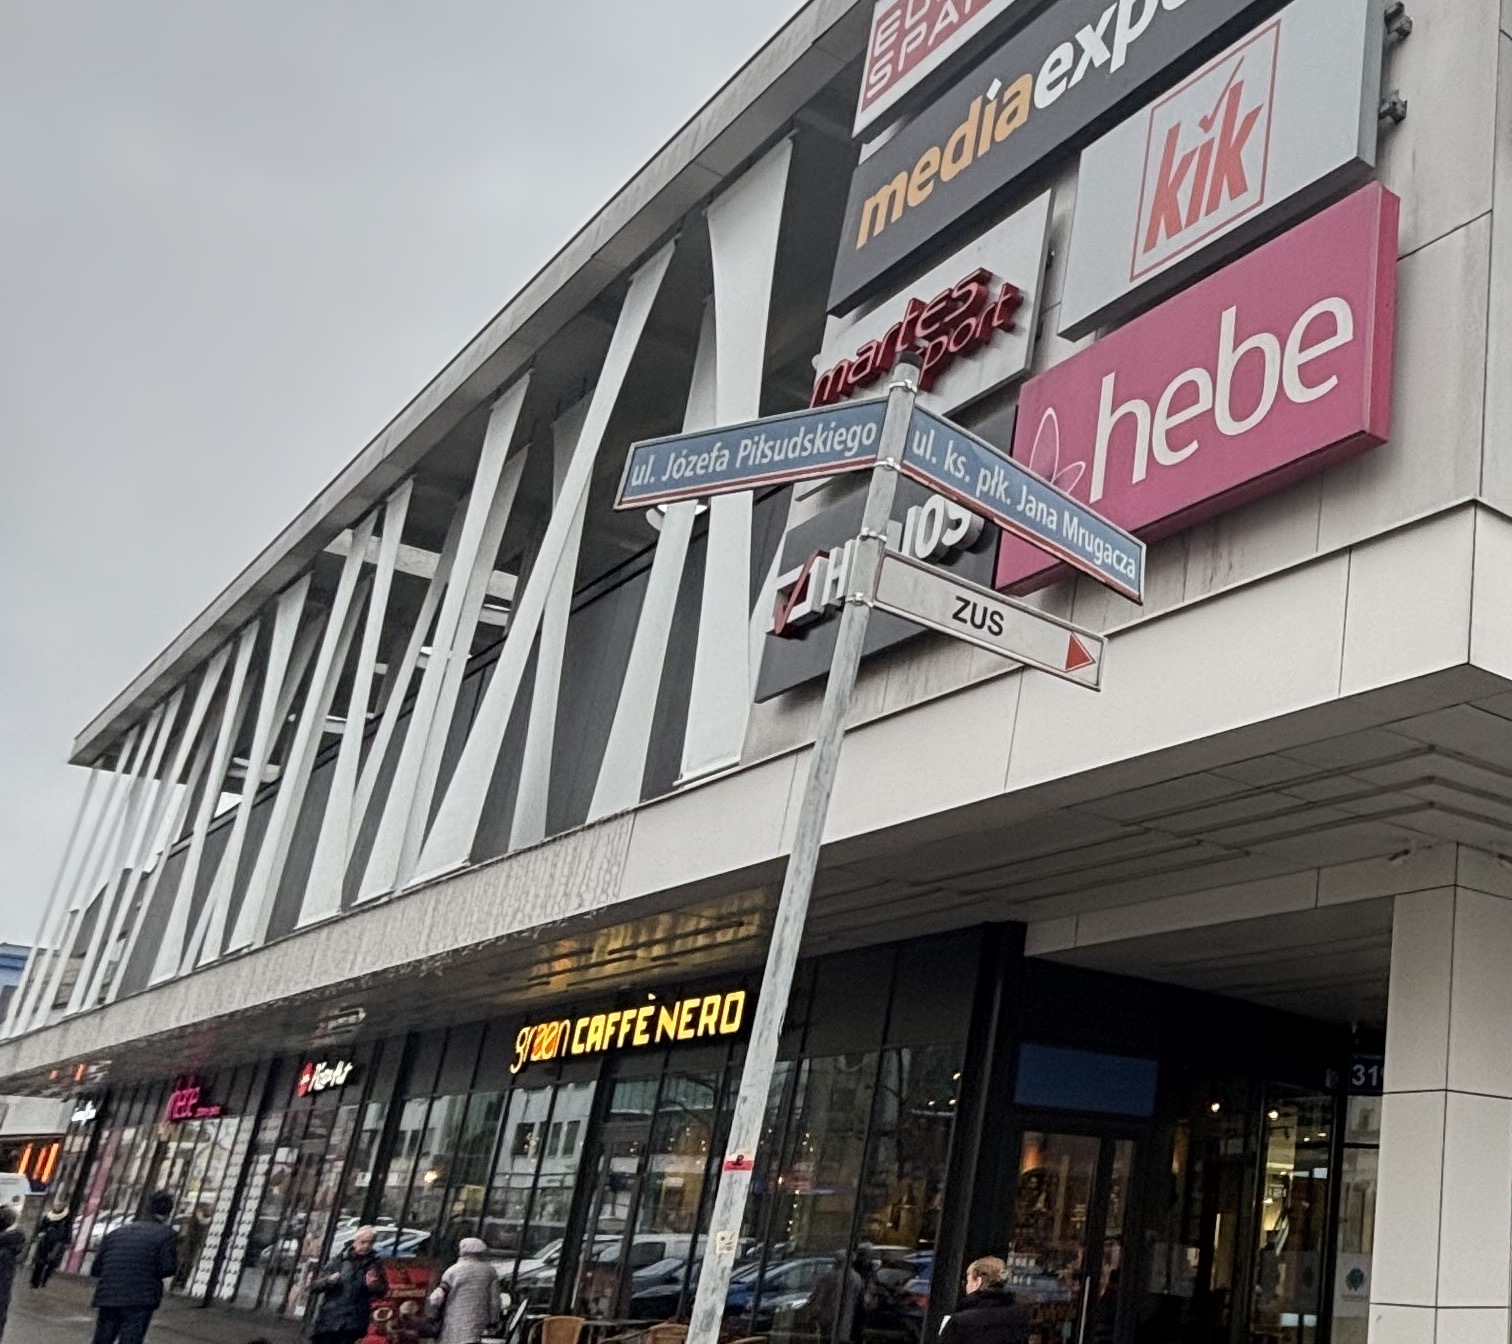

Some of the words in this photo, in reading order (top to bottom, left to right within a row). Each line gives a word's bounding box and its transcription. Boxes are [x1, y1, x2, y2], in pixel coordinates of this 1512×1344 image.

[809, 267, 986, 409] martes
[630, 457, 655, 487] ul.
[661, 441, 730, 482] Józefa
[735, 420, 878, 470] Piłsudskiego
[1089, 296, 1356, 505] hebe
[912, 428, 937, 465] ul.
[944, 439, 971, 484] ks.
[975, 463, 1012, 506] płk.
[1016, 484, 1058, 531] Jana
[1062, 510, 1137, 580] Mrugacza
[952, 594, 1005, 637] ZUS
[509, 1018, 571, 1075] green
[655, 990, 746, 1043] NERO
